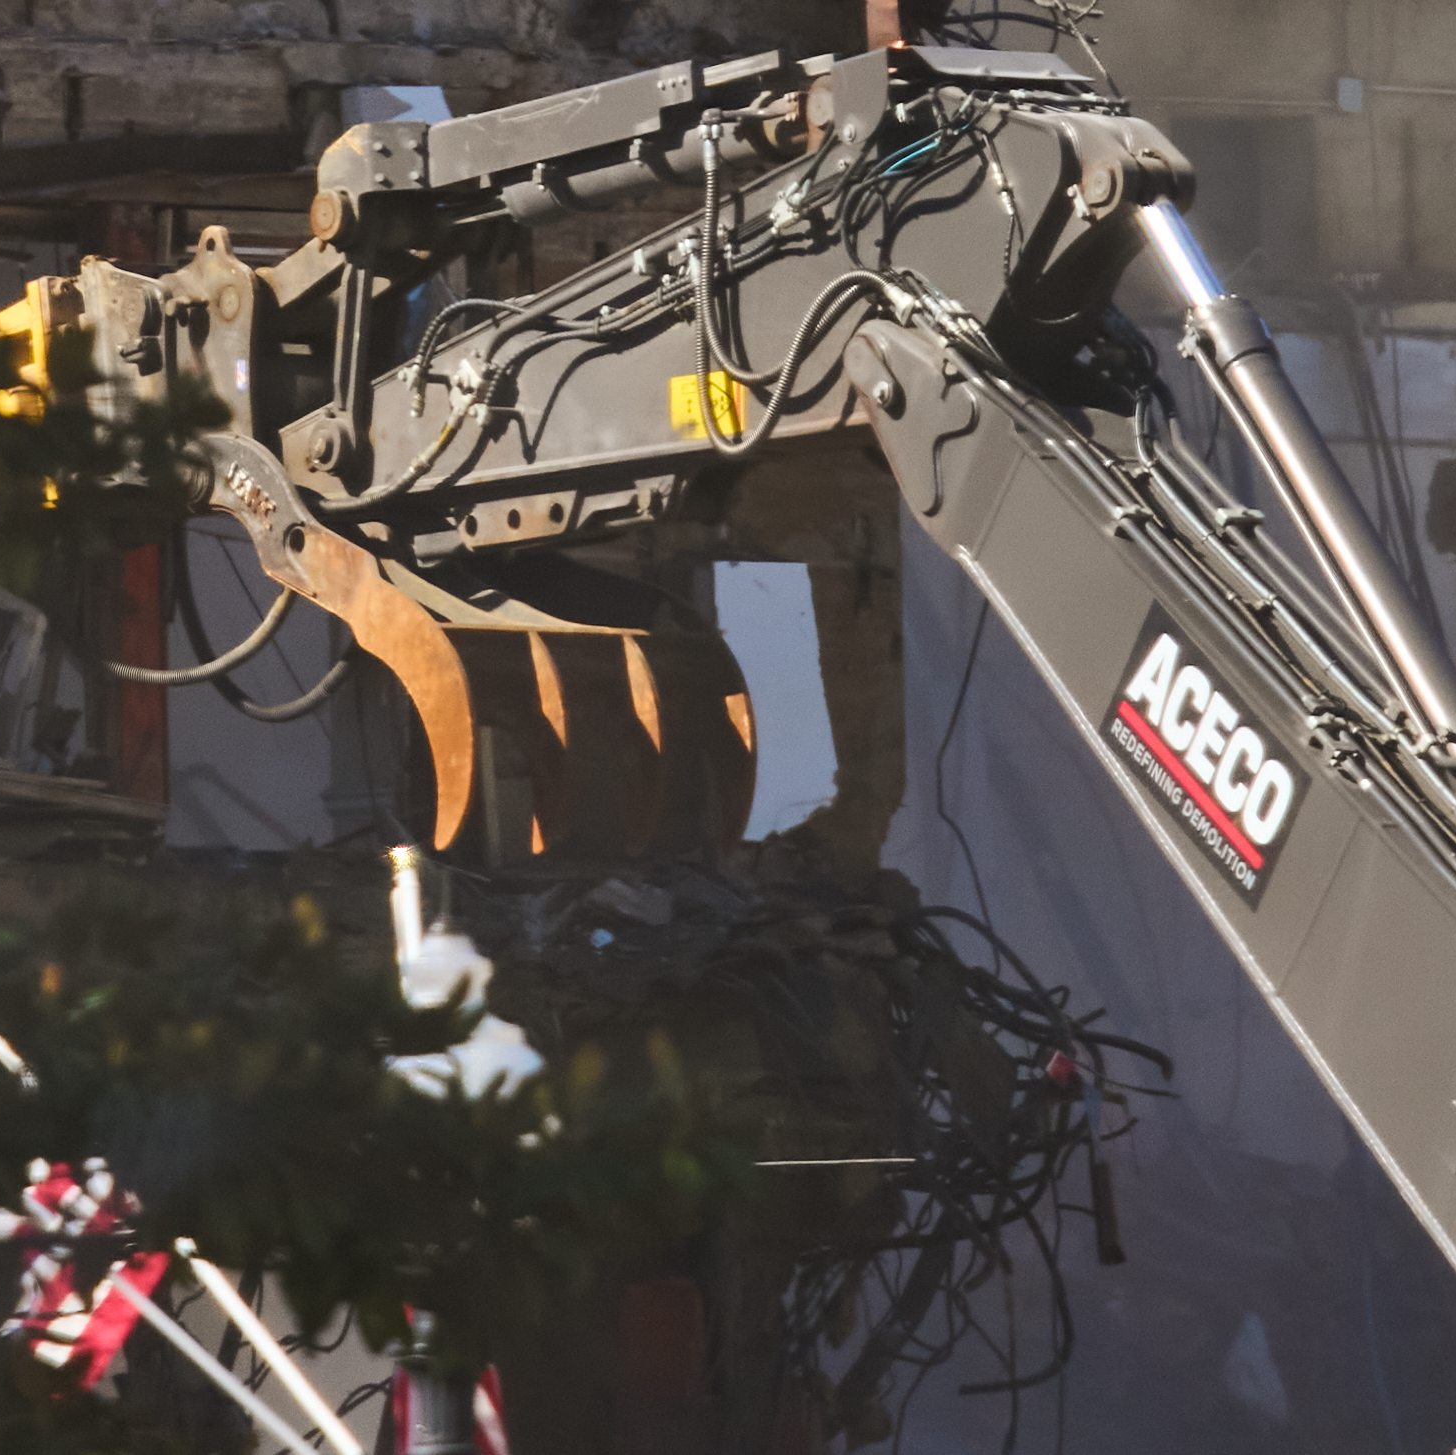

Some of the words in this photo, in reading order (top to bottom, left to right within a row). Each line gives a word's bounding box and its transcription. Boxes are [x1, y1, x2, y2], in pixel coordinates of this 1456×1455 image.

[1110, 717, 1182, 805] REDEFINING
[1181, 798, 1257, 890] DEMOLITION
[1125, 632, 1293, 845] ACECO
